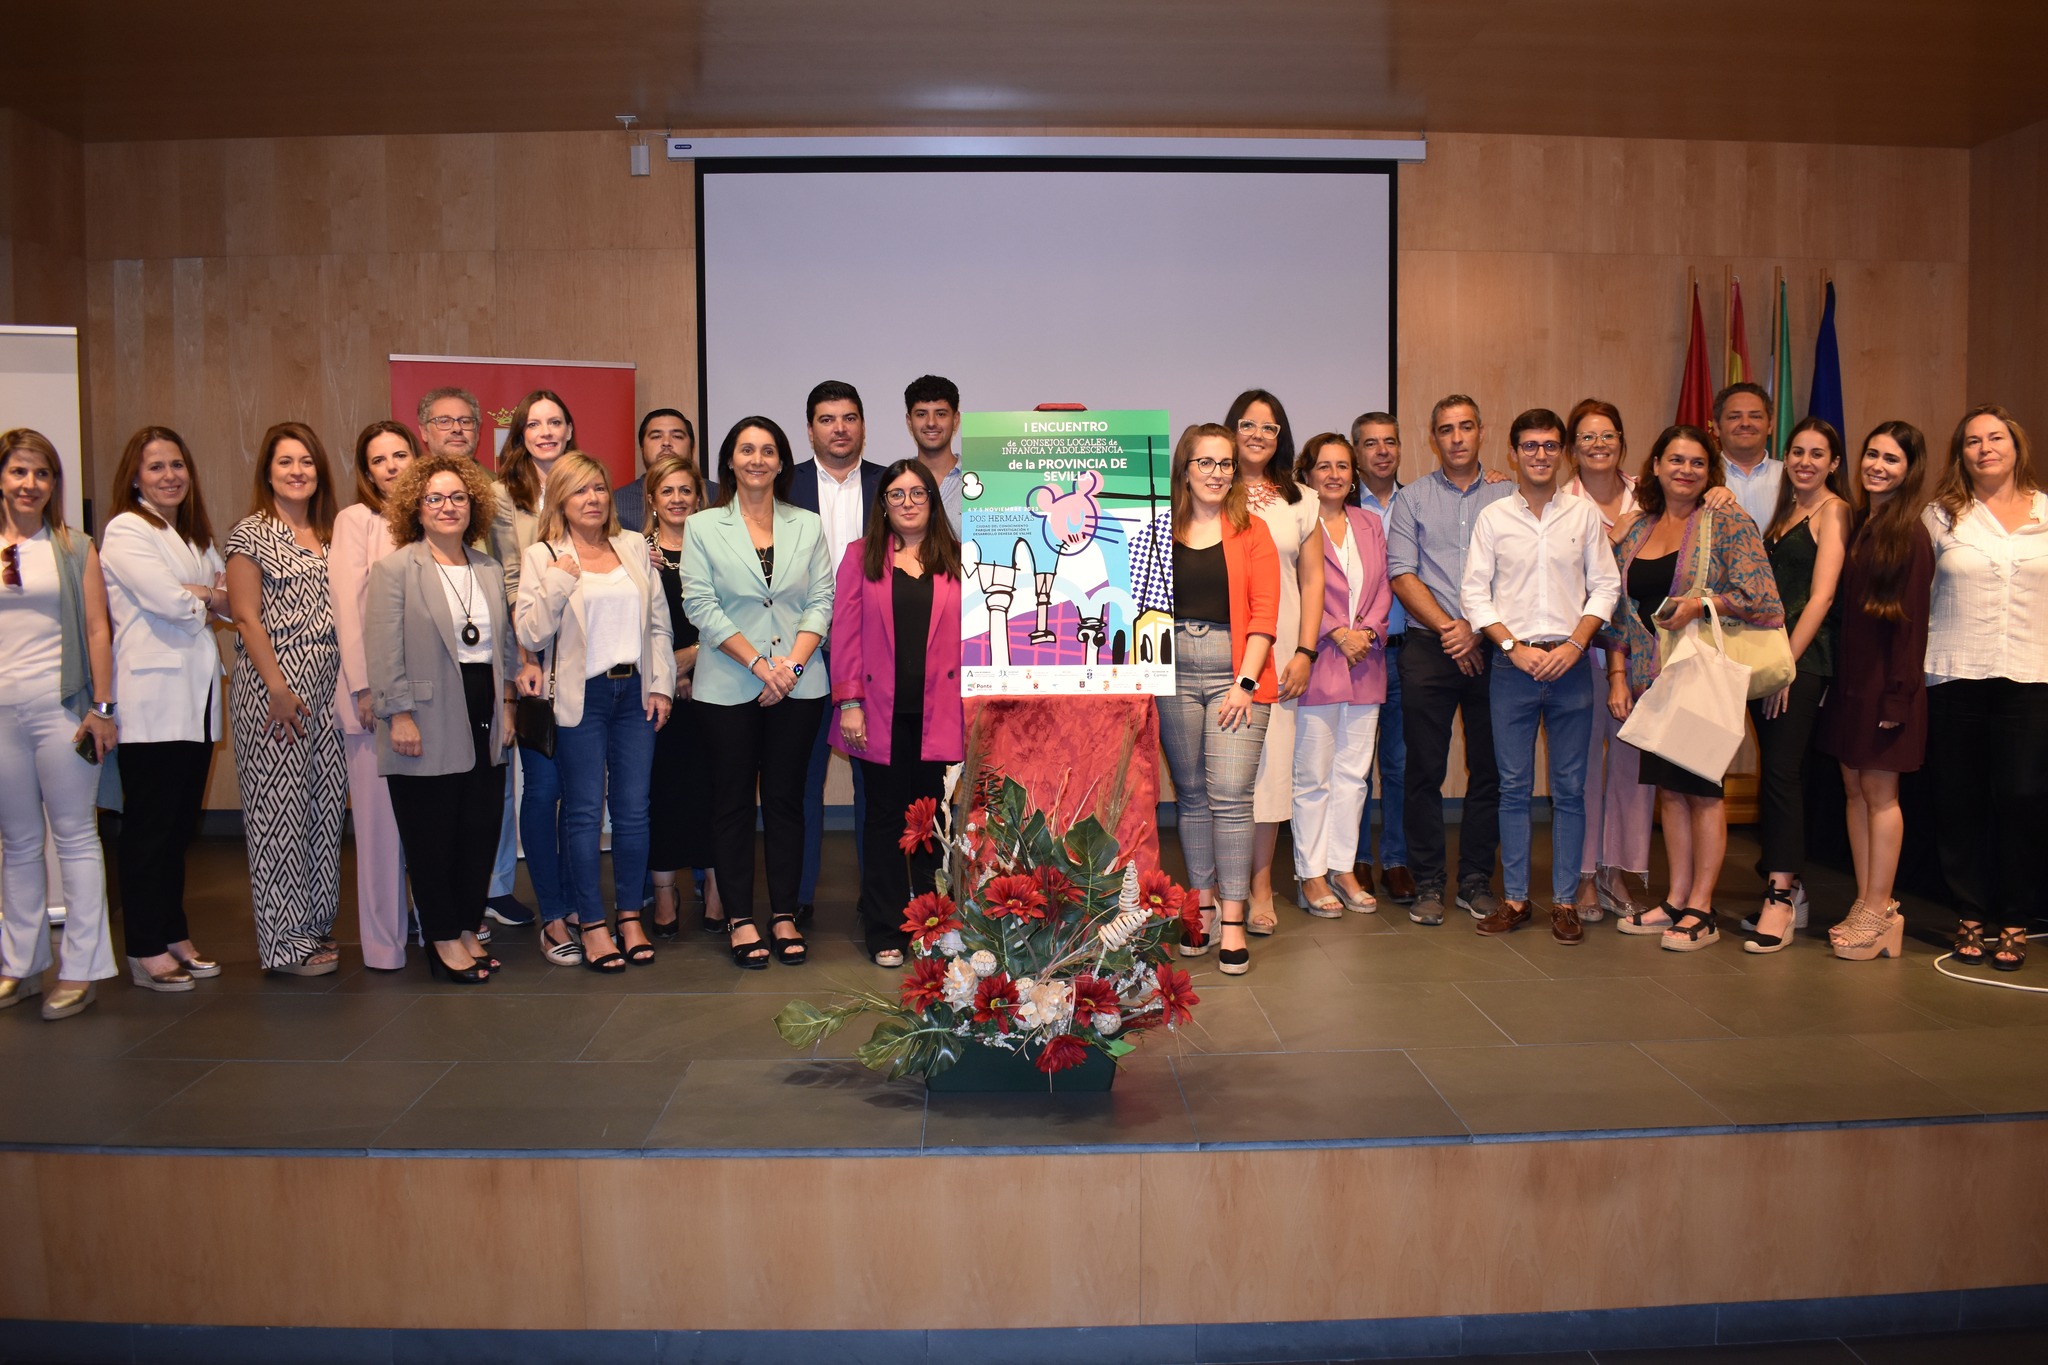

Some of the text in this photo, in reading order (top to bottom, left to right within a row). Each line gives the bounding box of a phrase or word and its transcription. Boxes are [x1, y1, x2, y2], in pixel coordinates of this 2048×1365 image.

[1024, 422, 1108, 432] I ENCUENTRO
[1020, 438, 1065, 446] CONSEJOS
[1067, 438, 1107, 446] LOCALES
[1002, 447, 1046, 455] INFANCIA
[1056, 446, 1124, 454] ADOLESCENCIA
[1008, 458, 1128, 470] de la PROVINCIA DE
[1044, 471, 1093, 482] SEVILLA
